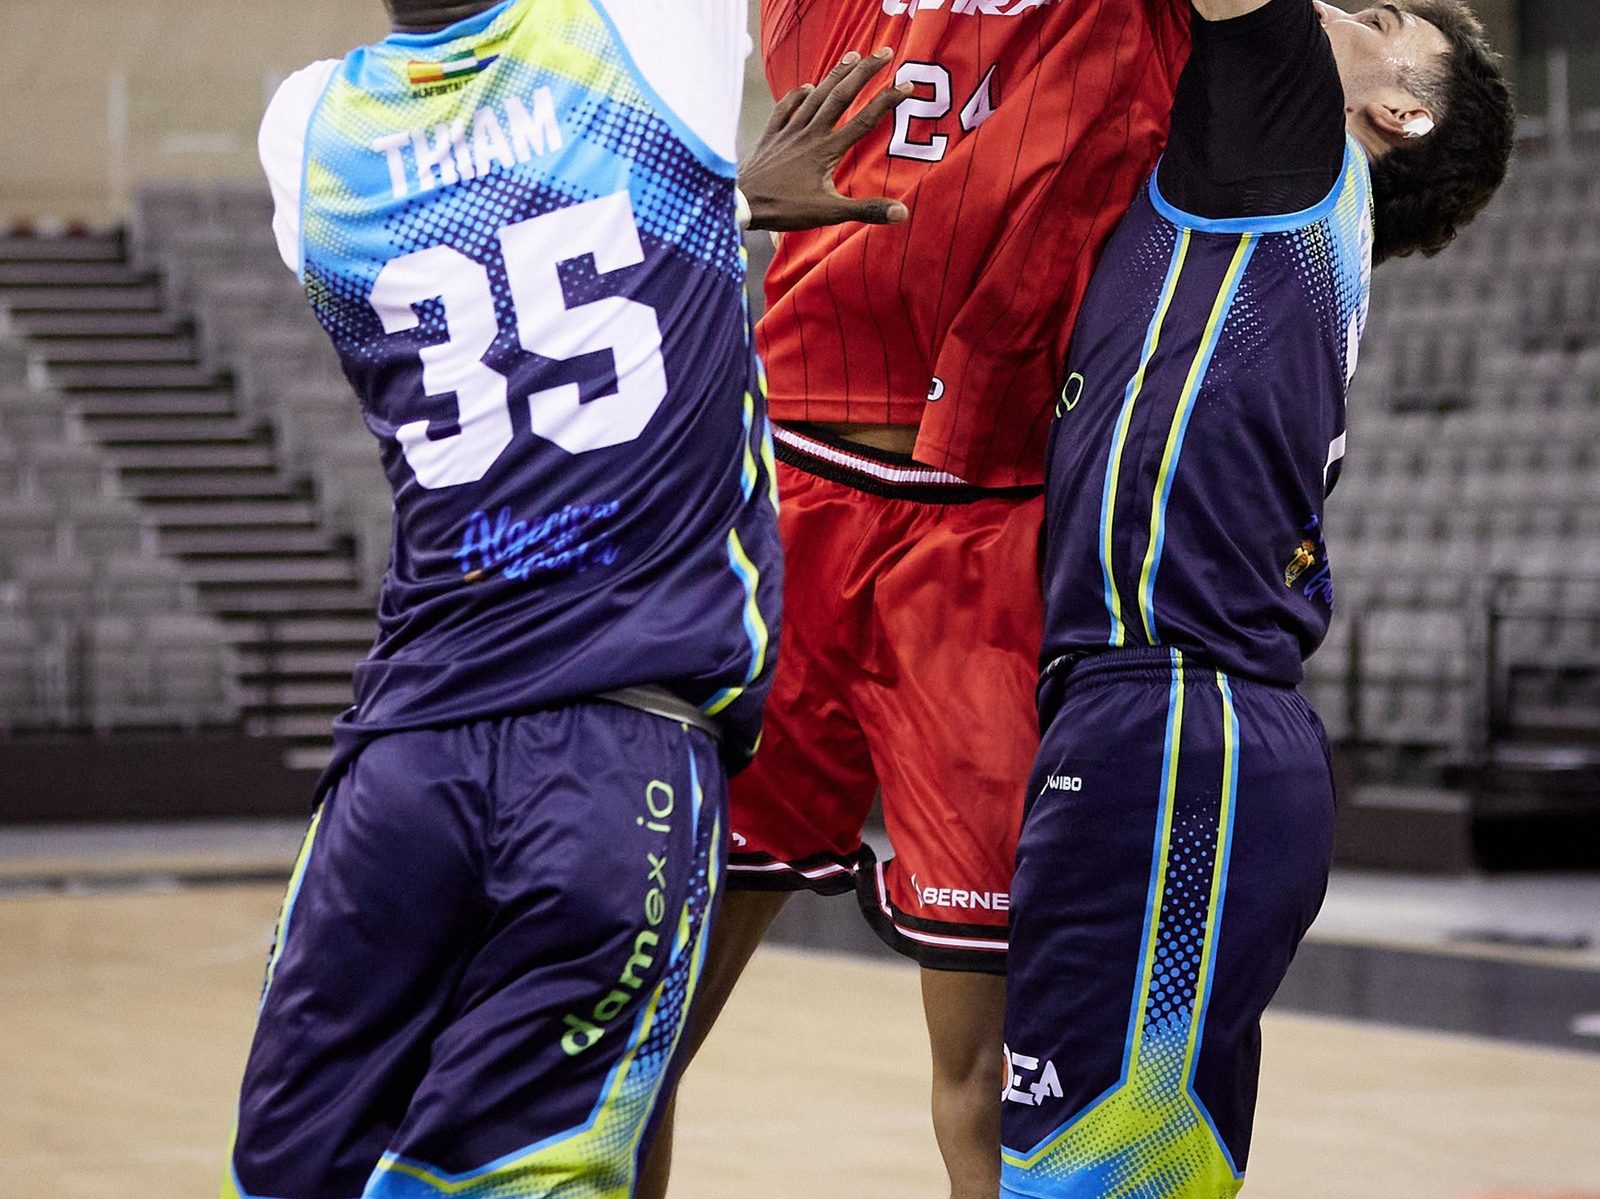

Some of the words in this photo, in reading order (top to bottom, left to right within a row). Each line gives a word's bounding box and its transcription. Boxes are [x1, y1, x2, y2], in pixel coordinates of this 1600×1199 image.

[371, 86, 565, 199] THIAM
[889, 60, 999, 162] 24
[368, 189, 669, 490] 35
